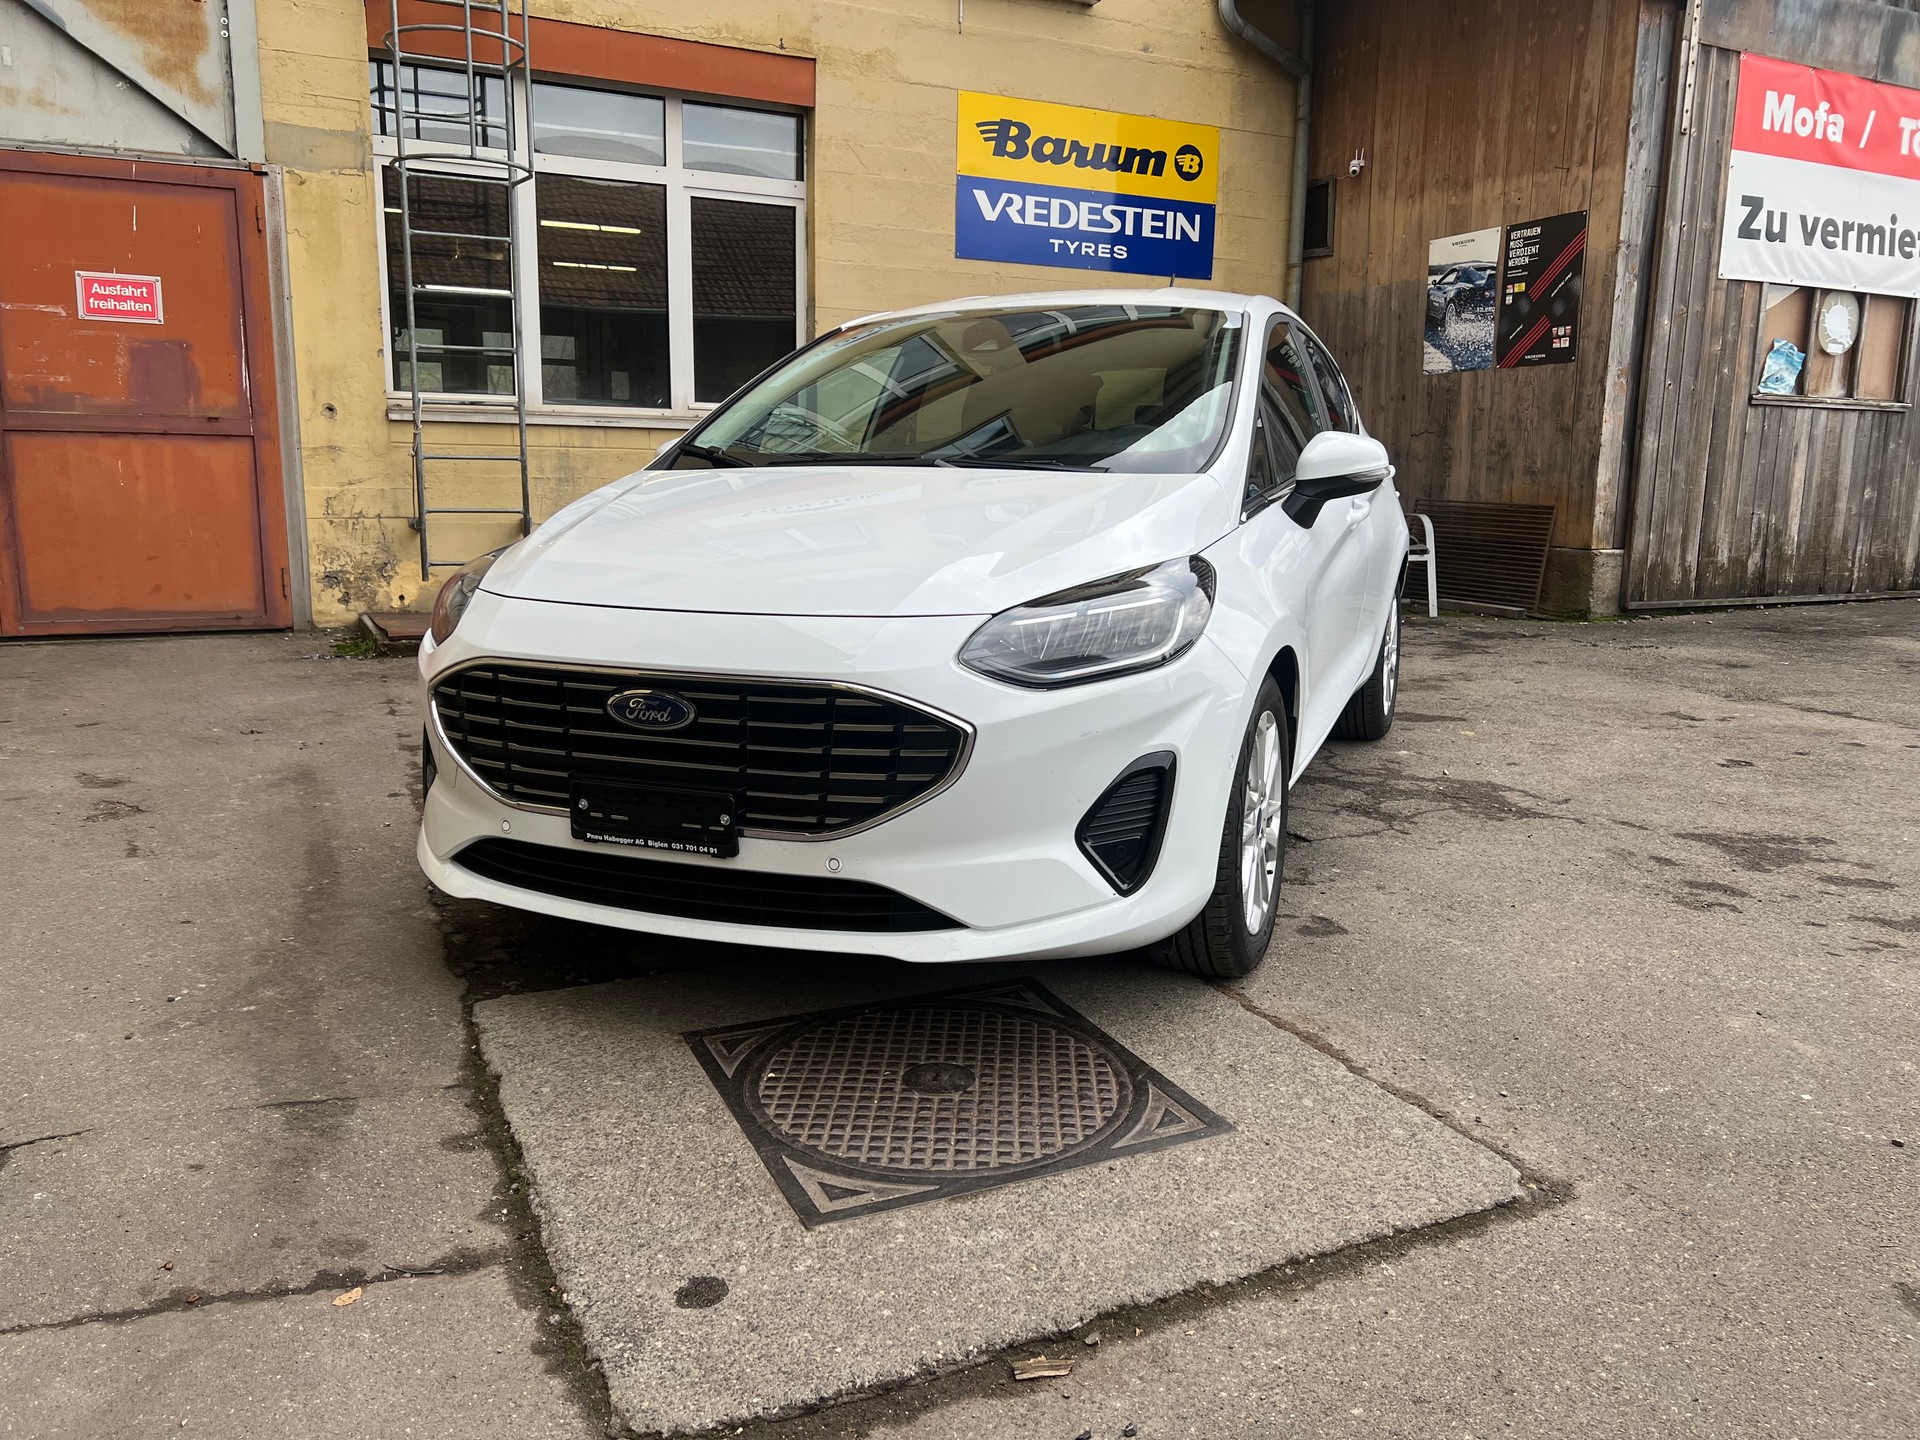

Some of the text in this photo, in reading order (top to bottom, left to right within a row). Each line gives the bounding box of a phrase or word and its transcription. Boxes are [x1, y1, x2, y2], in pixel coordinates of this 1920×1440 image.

[1762, 89, 1845, 144] Mofa
[1859, 110, 1877, 149] /
[975, 118, 1168, 177] Barum
[972, 188, 1201, 243] VREDESTEIN
[1510, 226, 1541, 240] VERTRAUEN
[1737, 194, 1920, 260] Zu vermie
[1049, 238, 1128, 260] TYRES
[1509, 239, 1524, 249] MUSS
[1509, 245, 1540, 258] VERDIENT
[1508, 256, 1529, 267] WERDEN
[91, 282, 148, 297] Ausfahrt
[89, 297, 152, 312] freihalten
[625, 698, 672, 723] Ford
[586, 832, 603, 840] Pneu
[603, 834, 634, 845] Habegger
[647, 840, 668, 848] Biglen
[671, 842, 684, 850] 031
[685, 844, 698, 852] 701
